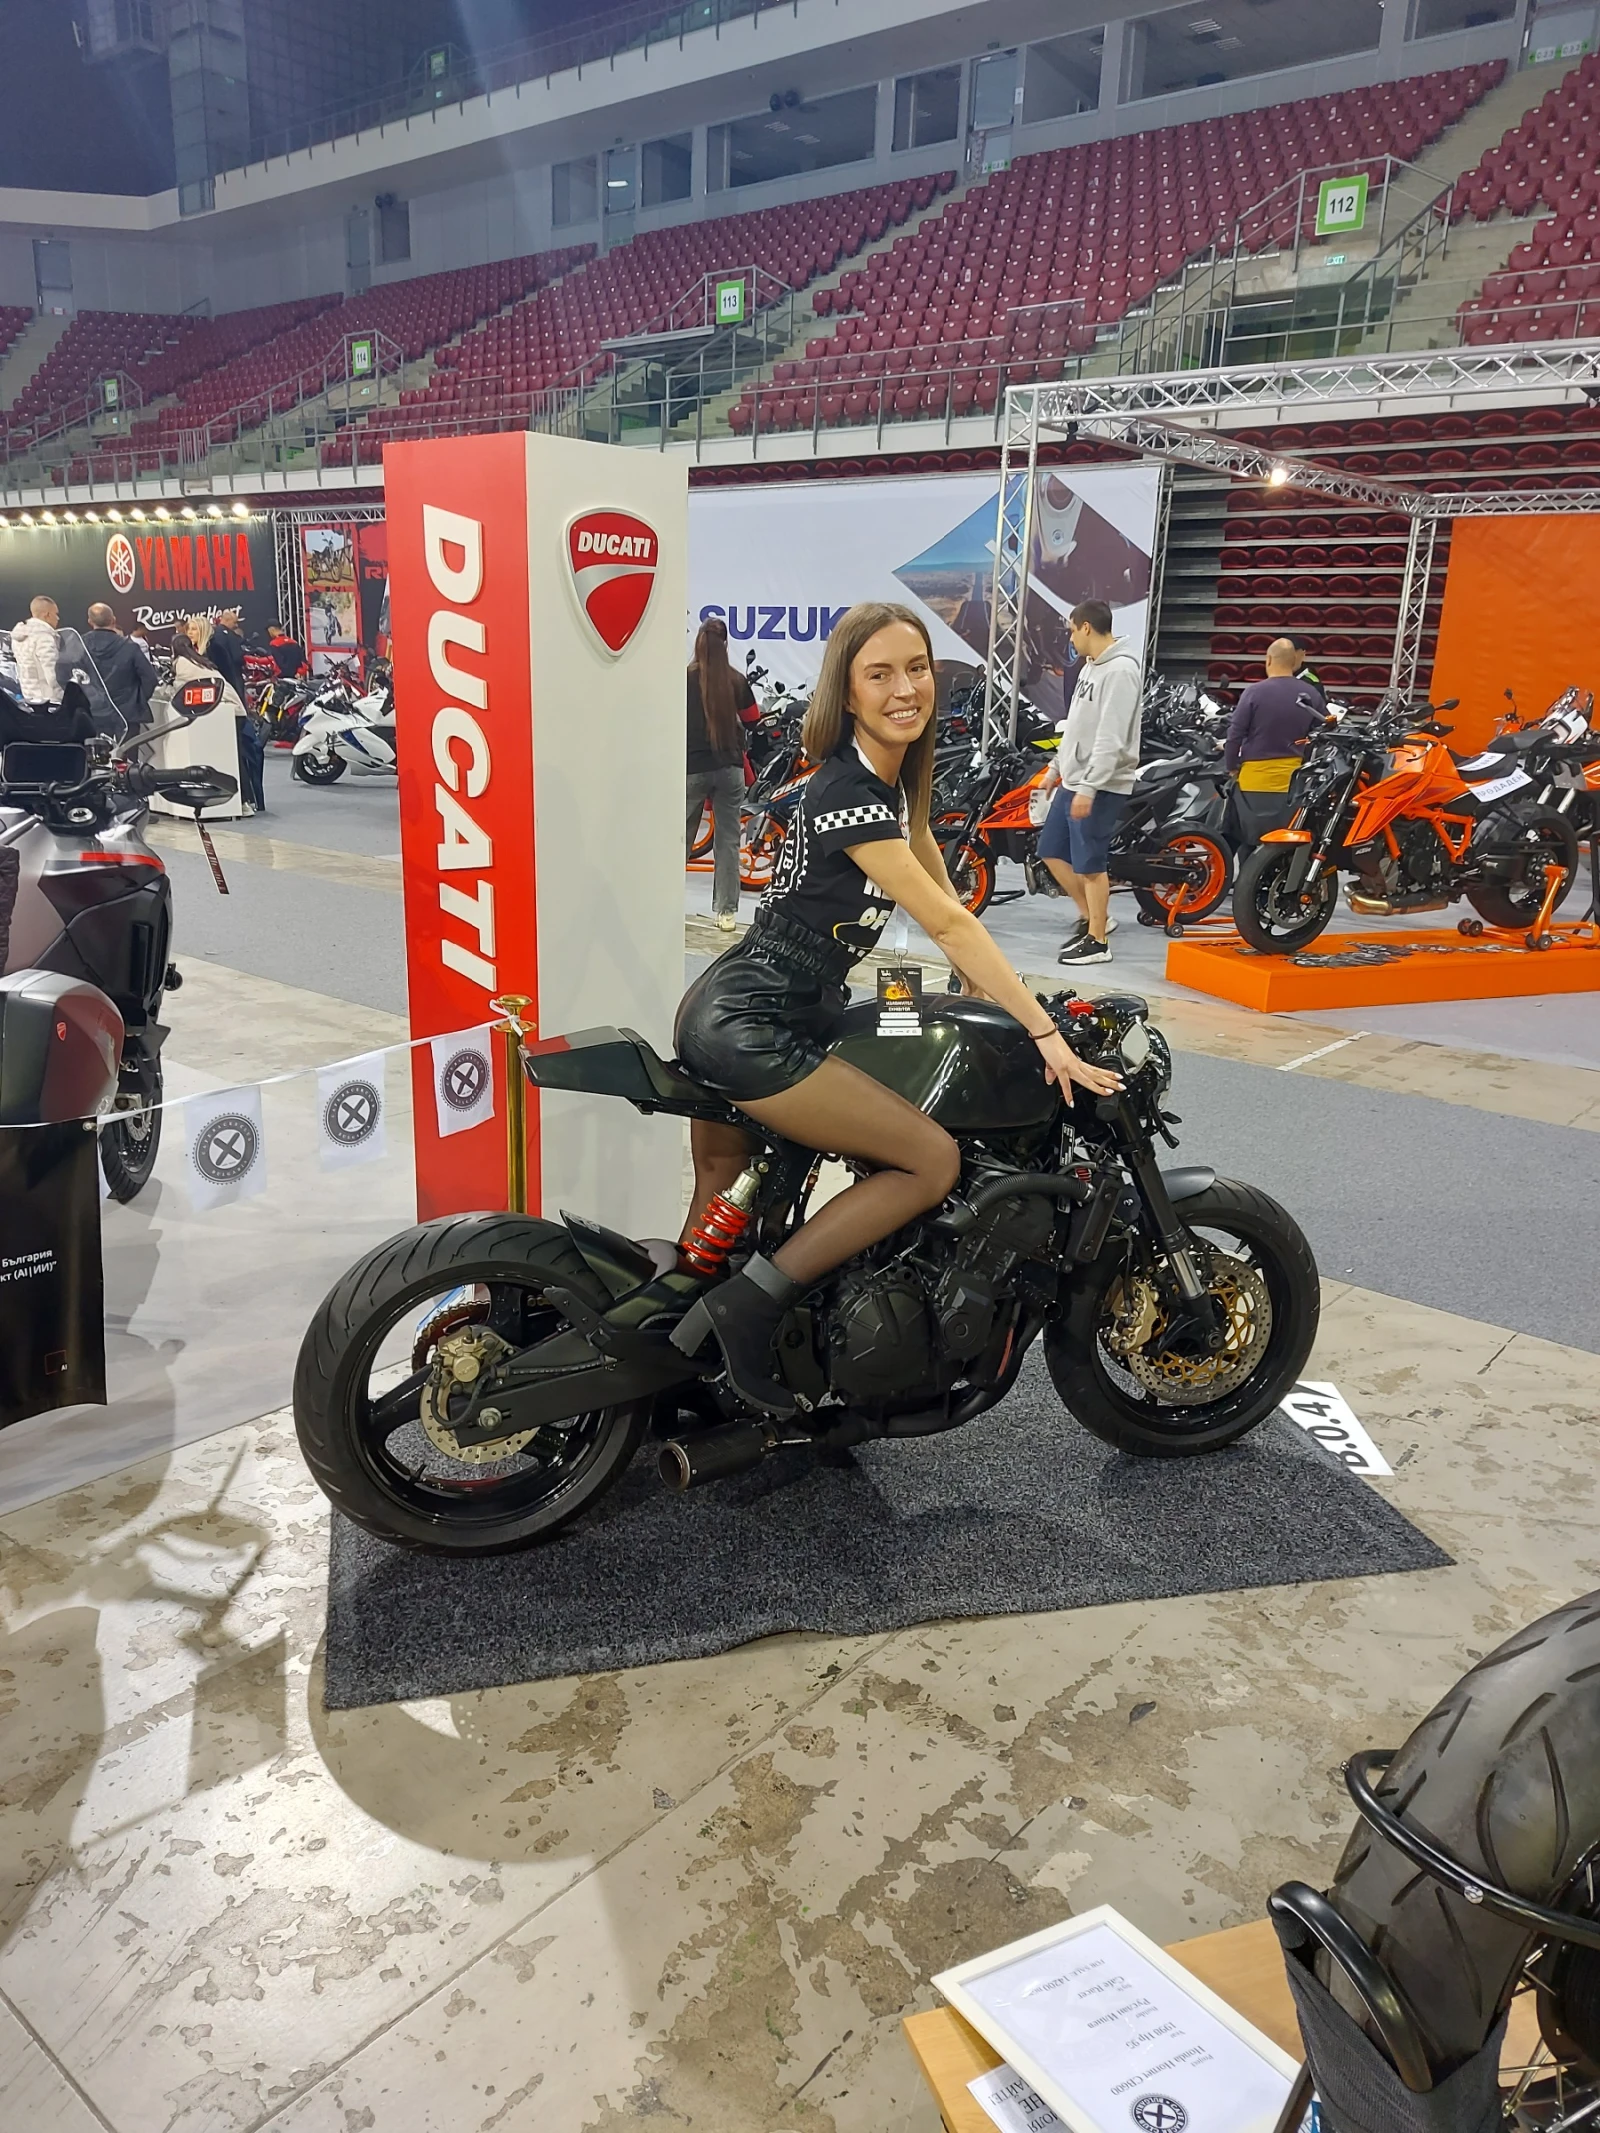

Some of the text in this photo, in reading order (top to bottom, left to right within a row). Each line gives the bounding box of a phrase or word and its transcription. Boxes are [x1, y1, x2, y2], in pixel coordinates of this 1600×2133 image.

[1329, 195, 1354, 215] 112
[722, 294, 737, 309] 113
[356, 351, 366, 363] 114
[577, 530, 652, 559] DUCATI
[135, 532, 255, 591] YAMAHA
[699, 604, 853, 642] UZUK
[422, 503, 497, 992] DUCATI
[1475, 773, 1525, 798] ПРОДАДЕН
[1, 1249, 53, 1268] България
[1077, 1984, 1105, 2000] Racer
[1110, 2045, 1206, 2096] Honda Hornet CB600
[988, 2076, 1030, 2106] АЙТЕ!
[1018, 2092, 1046, 2115] НЕ
